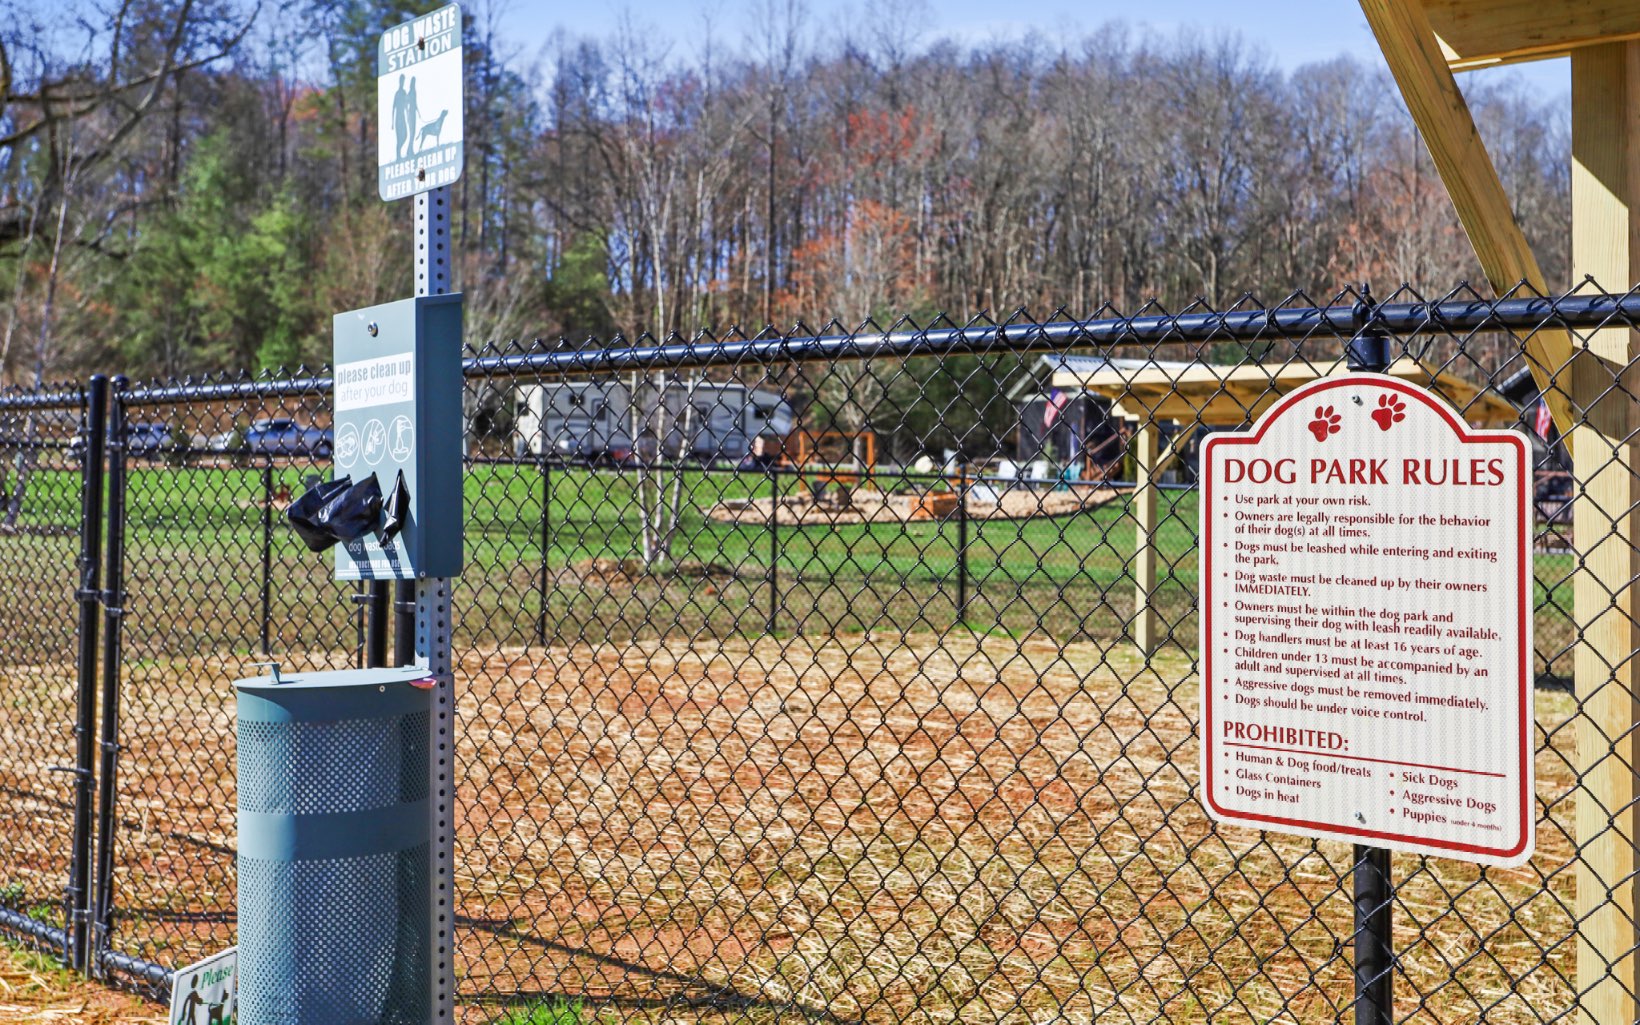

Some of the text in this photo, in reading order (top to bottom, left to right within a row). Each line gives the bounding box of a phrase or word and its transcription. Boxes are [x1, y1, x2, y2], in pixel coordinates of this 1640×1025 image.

[384, 6, 456, 53] DOG WASTE
[388, 33, 452, 71] STATION
[385, 146, 456, 180] PLEASE CLEAN UP
[387, 179, 412, 198] AFTER
[438, 166, 456, 183] DOG
[338, 360, 411, 386] please clean up
[341, 380, 408, 402] after your dog
[1224, 458, 1504, 486] DOG PARK RULES
[1235, 494, 1371, 508] Use park at your own risk.
[1234, 511, 1490, 527] Owners are legally responsible for the behavior
[1234, 524, 1371, 538] of their dog(s) at all times.
[349, 543, 361, 554] dog
[1234, 541, 1497, 562] Dogs must be leashed while entering and exiting
[1234, 554, 1279, 567] the park.
[1234, 571, 1488, 592] Dog waste must be cleaned up by their owners
[1234, 583, 1311, 596] IMMEDIATELY.
[1234, 601, 1454, 623] Owners must be within the dog park and
[1234, 615, 1291, 628] supervising
[1294, 617, 1319, 628] their
[1321, 618, 1342, 632] dog
[1345, 620, 1369, 632] with
[1372, 621, 1400, 633] leash
[1404, 624, 1442, 638] readily
[1234, 629, 1483, 659] Dog handlers must be at least 16 years of age.
[1234, 647, 1488, 676] Children under 13 must be accompanied by an
[1234, 660, 1407, 685] adult and supervised at all times.
[1234, 676, 1489, 710] Aggressive dogs must be removed immediately.
[1235, 693, 1427, 721] Dogs should be under voice control.
[1223, 721, 1350, 751] PROHIBITED:
[1235, 751, 1372, 778] Human & Dog food/treats
[1235, 768, 1322, 789] Glass Containers
[1402, 771, 1458, 789] Sick Dogs
[1236, 786, 1300, 803] Dogs in heat
[1402, 790, 1497, 812] Aggressive Dogs
[1403, 808, 1447, 824] Puppies
[201, 965, 233, 990] Please
